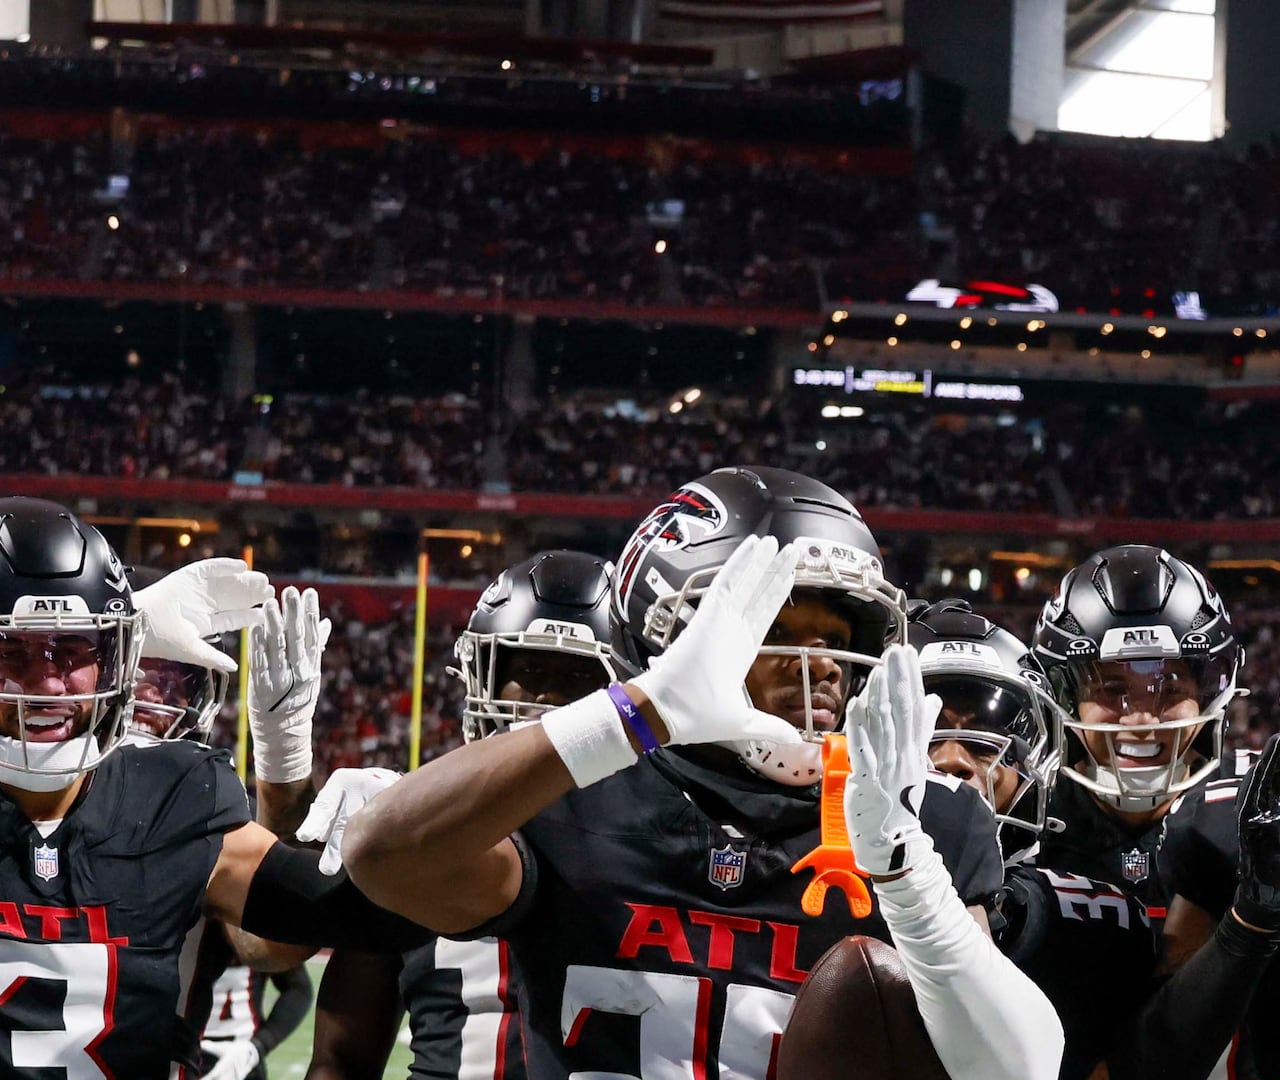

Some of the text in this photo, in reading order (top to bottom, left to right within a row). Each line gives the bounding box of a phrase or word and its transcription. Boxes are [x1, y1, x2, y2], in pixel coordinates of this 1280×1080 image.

[831, 546, 857, 563] ATL
[34, 599, 73, 613] ATL
[543, 624, 578, 637] ATL
[1123, 629, 1160, 643] ATL
[941, 641, 982, 656] ATL
[616, 903, 809, 984] ATL
